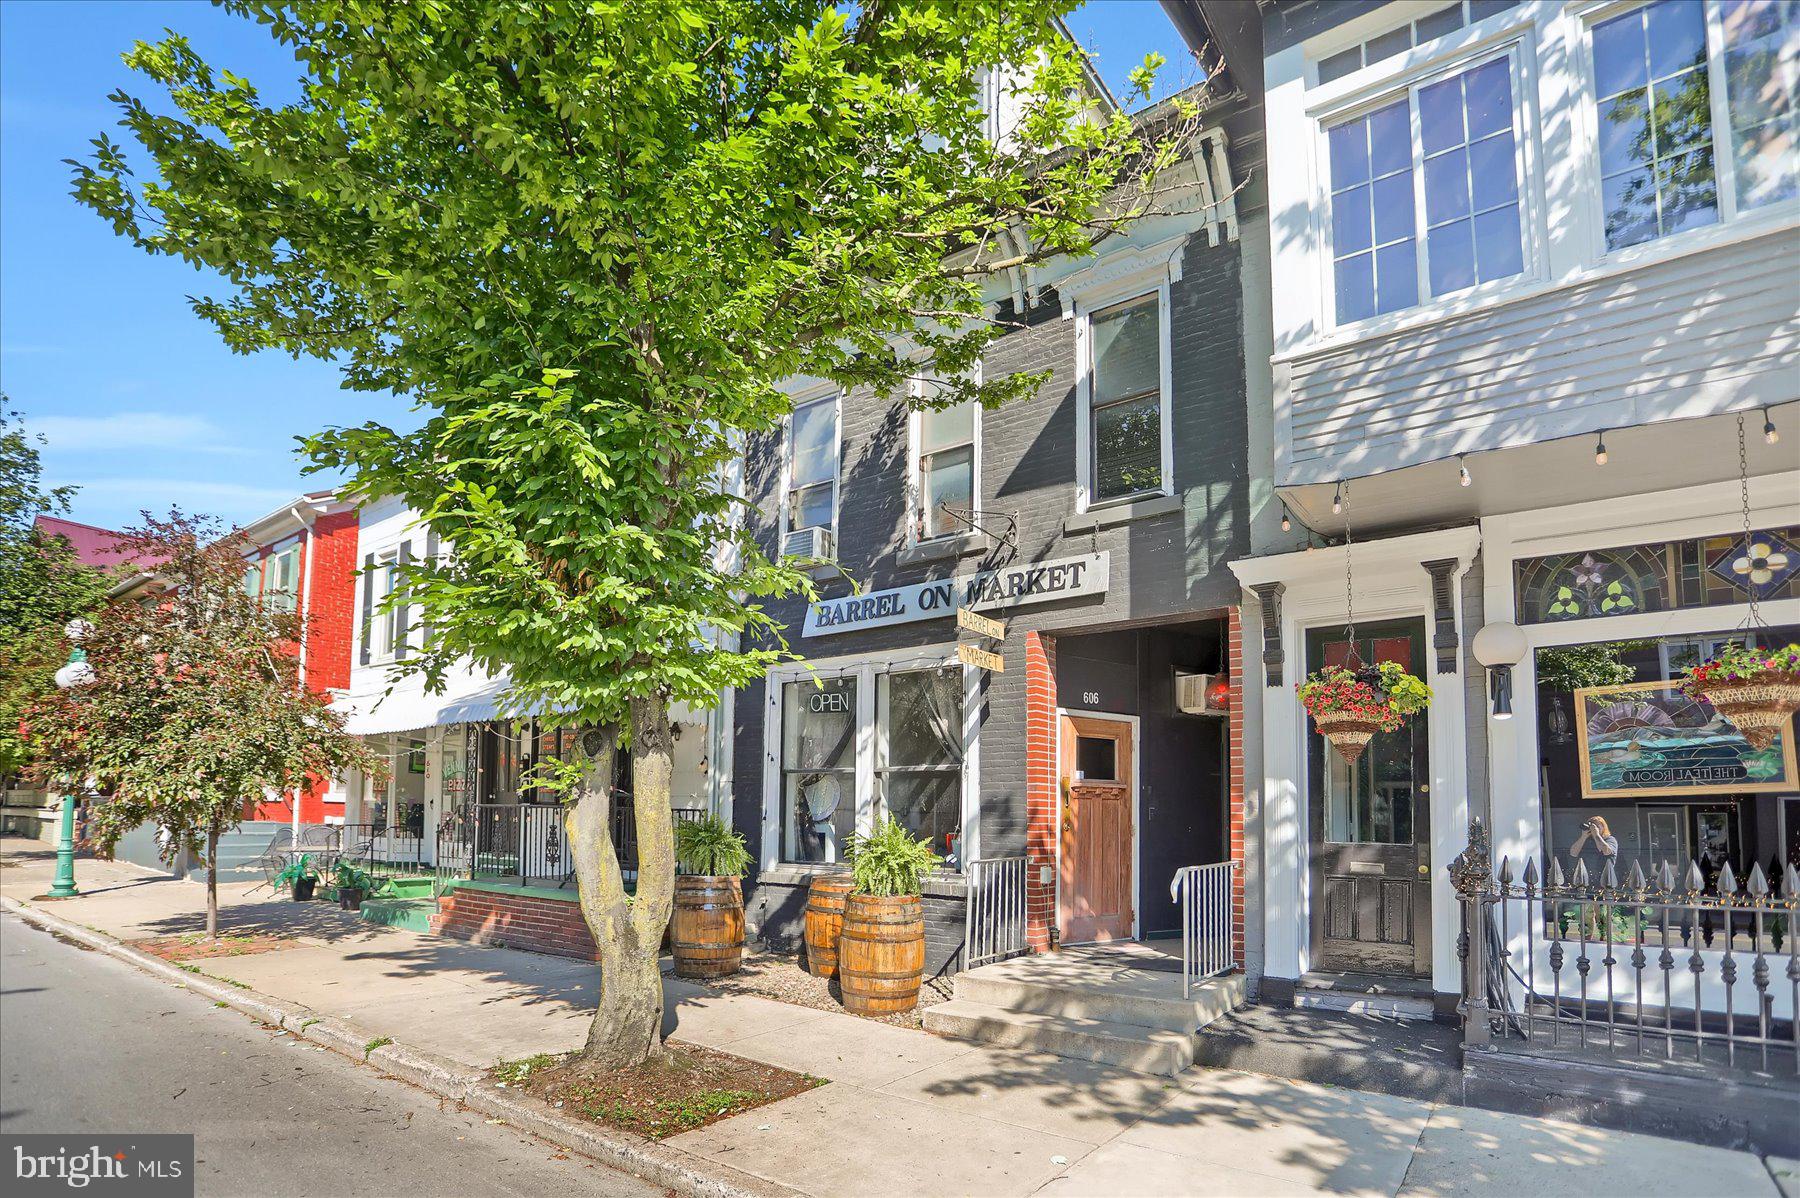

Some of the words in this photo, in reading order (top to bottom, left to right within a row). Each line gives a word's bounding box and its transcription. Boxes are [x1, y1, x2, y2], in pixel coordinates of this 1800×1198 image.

[815, 593, 905, 628] BARREL
[918, 583, 953, 610] ON
[965, 562, 1086, 605] MARKET
[962, 611, 992, 635] BARREL
[966, 646, 998, 670] MARKET
[811, 692, 849, 712] OPEN
[1083, 691, 1099, 704] 606
